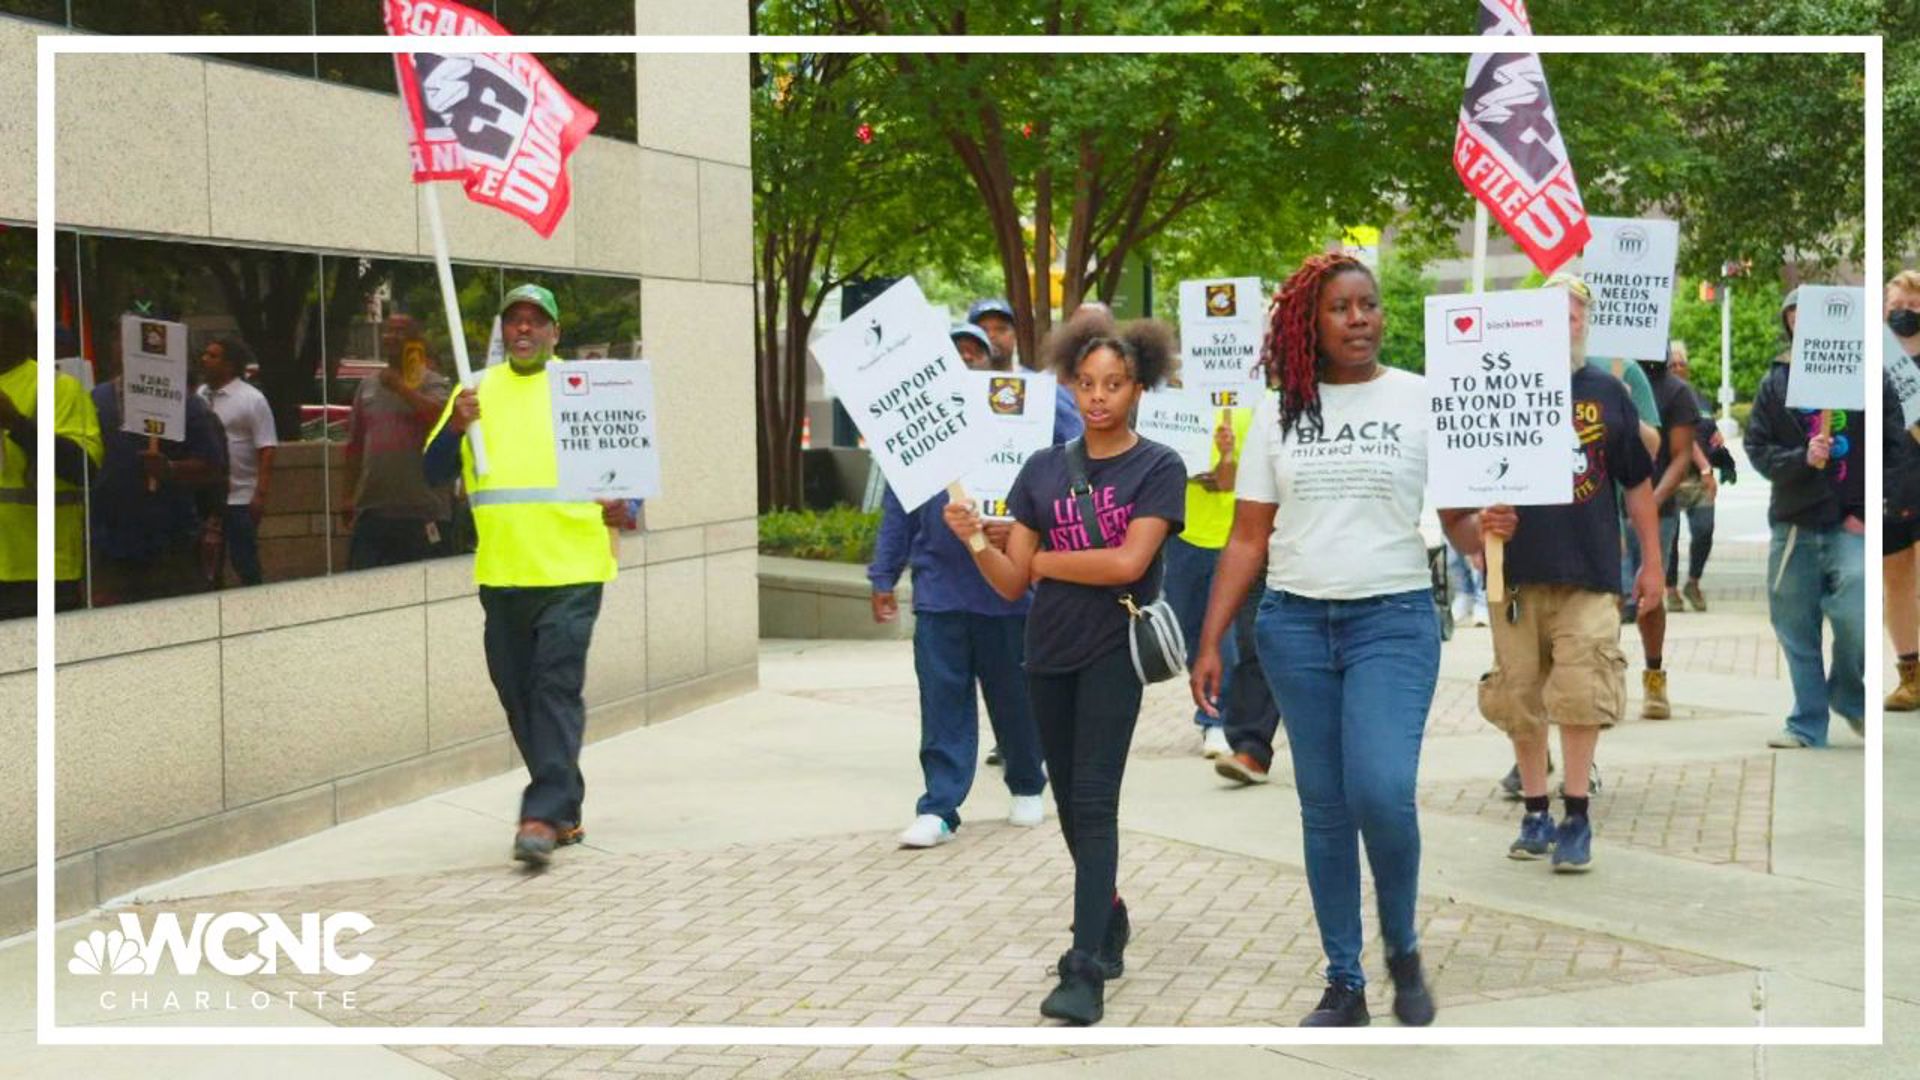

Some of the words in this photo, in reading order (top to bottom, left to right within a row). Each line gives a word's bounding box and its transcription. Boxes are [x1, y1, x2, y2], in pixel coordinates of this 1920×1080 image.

[1467, 159, 1531, 218] FILE
[1513, 168, 1584, 250] UN
[1585, 272, 1669, 288] CHARLOTTE
[1600, 287, 1651, 301] NEEDS
[1192, 345, 1254, 357] MINIMUM
[1804, 338, 1863, 351] PROTECT
[1203, 358, 1243, 371] WAGE
[1481, 352, 1512, 371] $$
[1803, 350, 1863, 363] TENANTS
[1805, 362, 1858, 375] RIGHTS!
[868, 356, 948, 419] SUPPORT
[1451, 376, 1477, 392] TO
[1485, 373, 1545, 390] MOVE
[897, 390, 935, 422] THE
[1210, 390, 1239, 407] UE
[1431, 394, 1516, 413] BEYOND
[1525, 390, 1564, 407] THE
[561, 409, 647, 423] REACHING
[1436, 412, 1501, 431] BLOCK
[1510, 410, 1560, 427] INTO
[570, 423, 640, 437] BEYOND
[1297, 422, 1402, 444] BLACK
[561, 438, 591, 451] THE
[598, 436, 651, 450] BLOCK
[900, 411, 969, 467] BUDGET
[1447, 430, 1544, 449] HOUSING
[1292, 444, 1352, 458] mixed
[1360, 441, 1402, 458] with
[990, 452, 1024, 465] AISE
